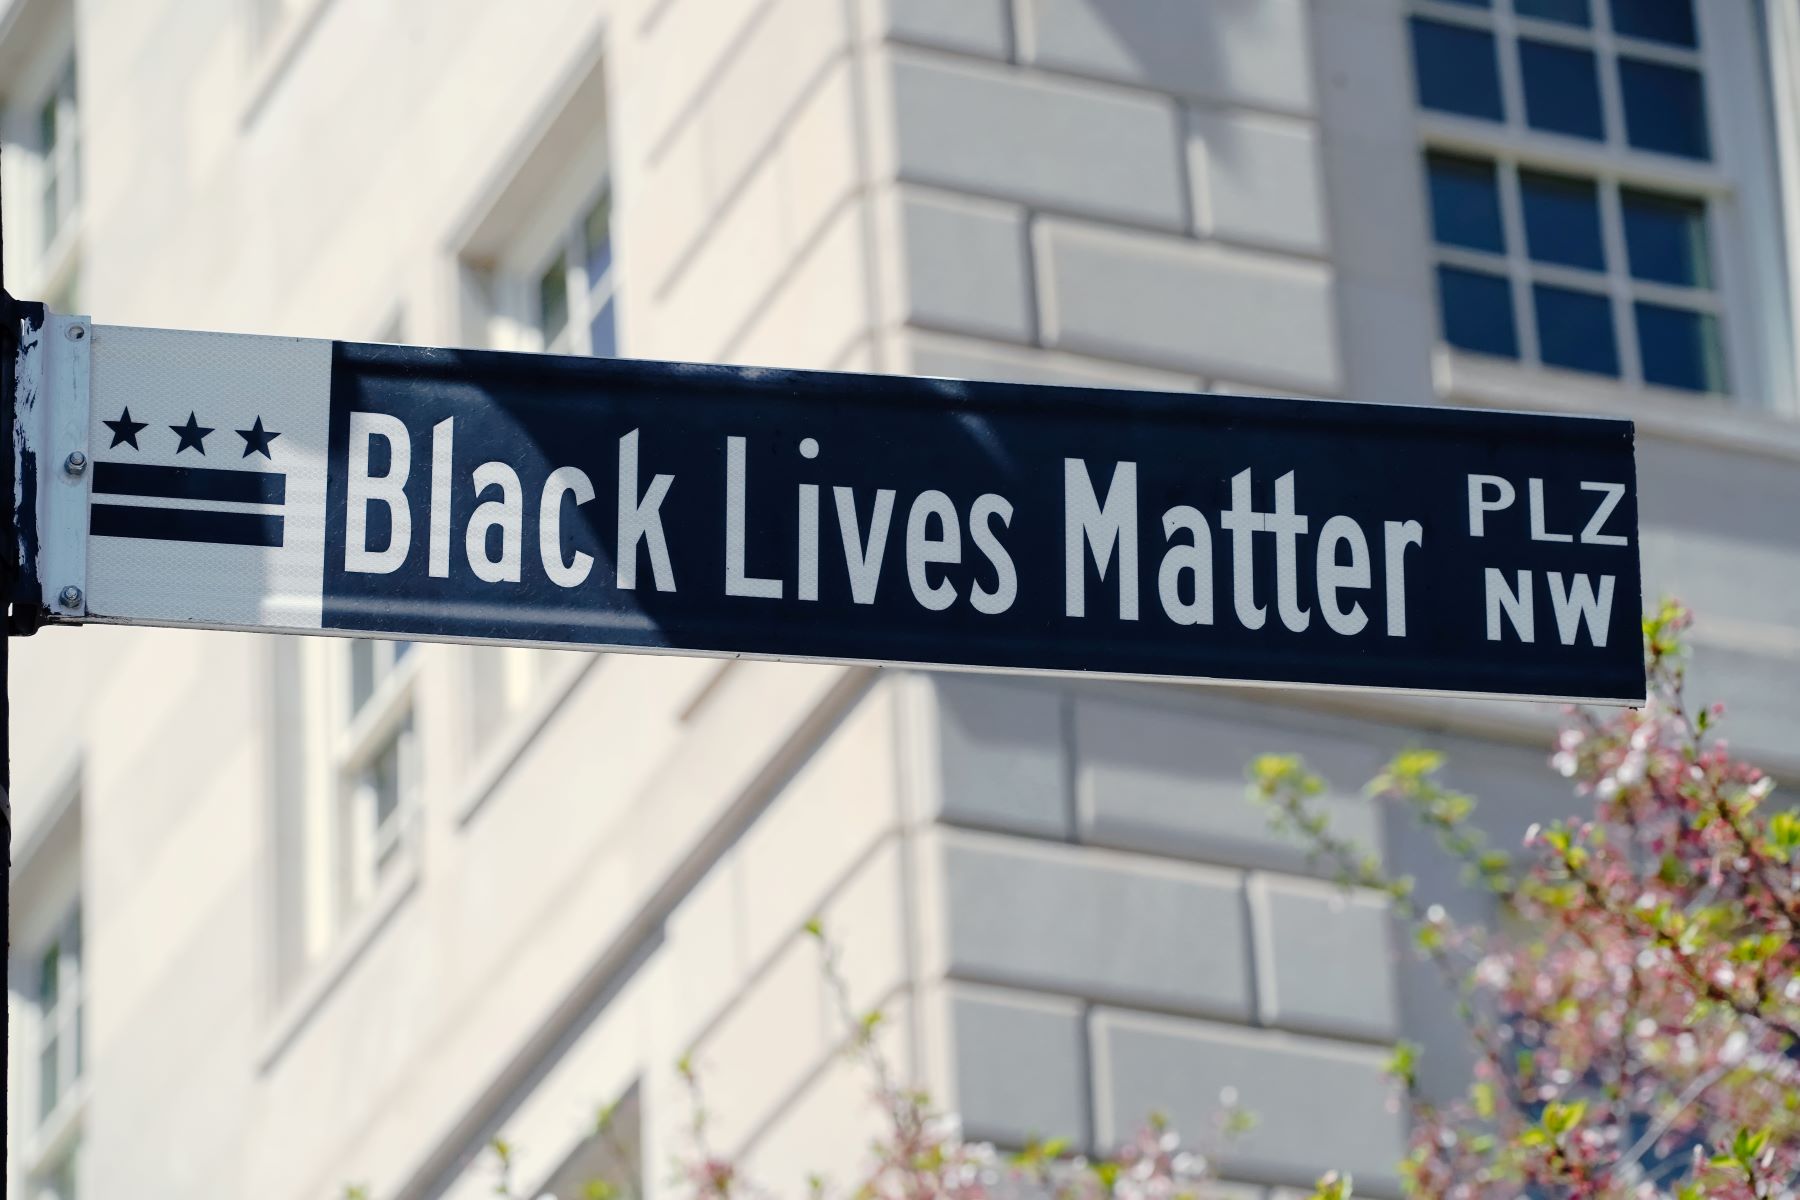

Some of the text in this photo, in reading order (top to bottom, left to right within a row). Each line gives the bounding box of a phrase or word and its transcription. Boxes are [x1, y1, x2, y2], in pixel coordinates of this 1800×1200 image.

[344, 411, 1423, 637] Black Lives Matter
[1467, 474, 1628, 546] PLZ
[1484, 567, 1616, 648] NW
